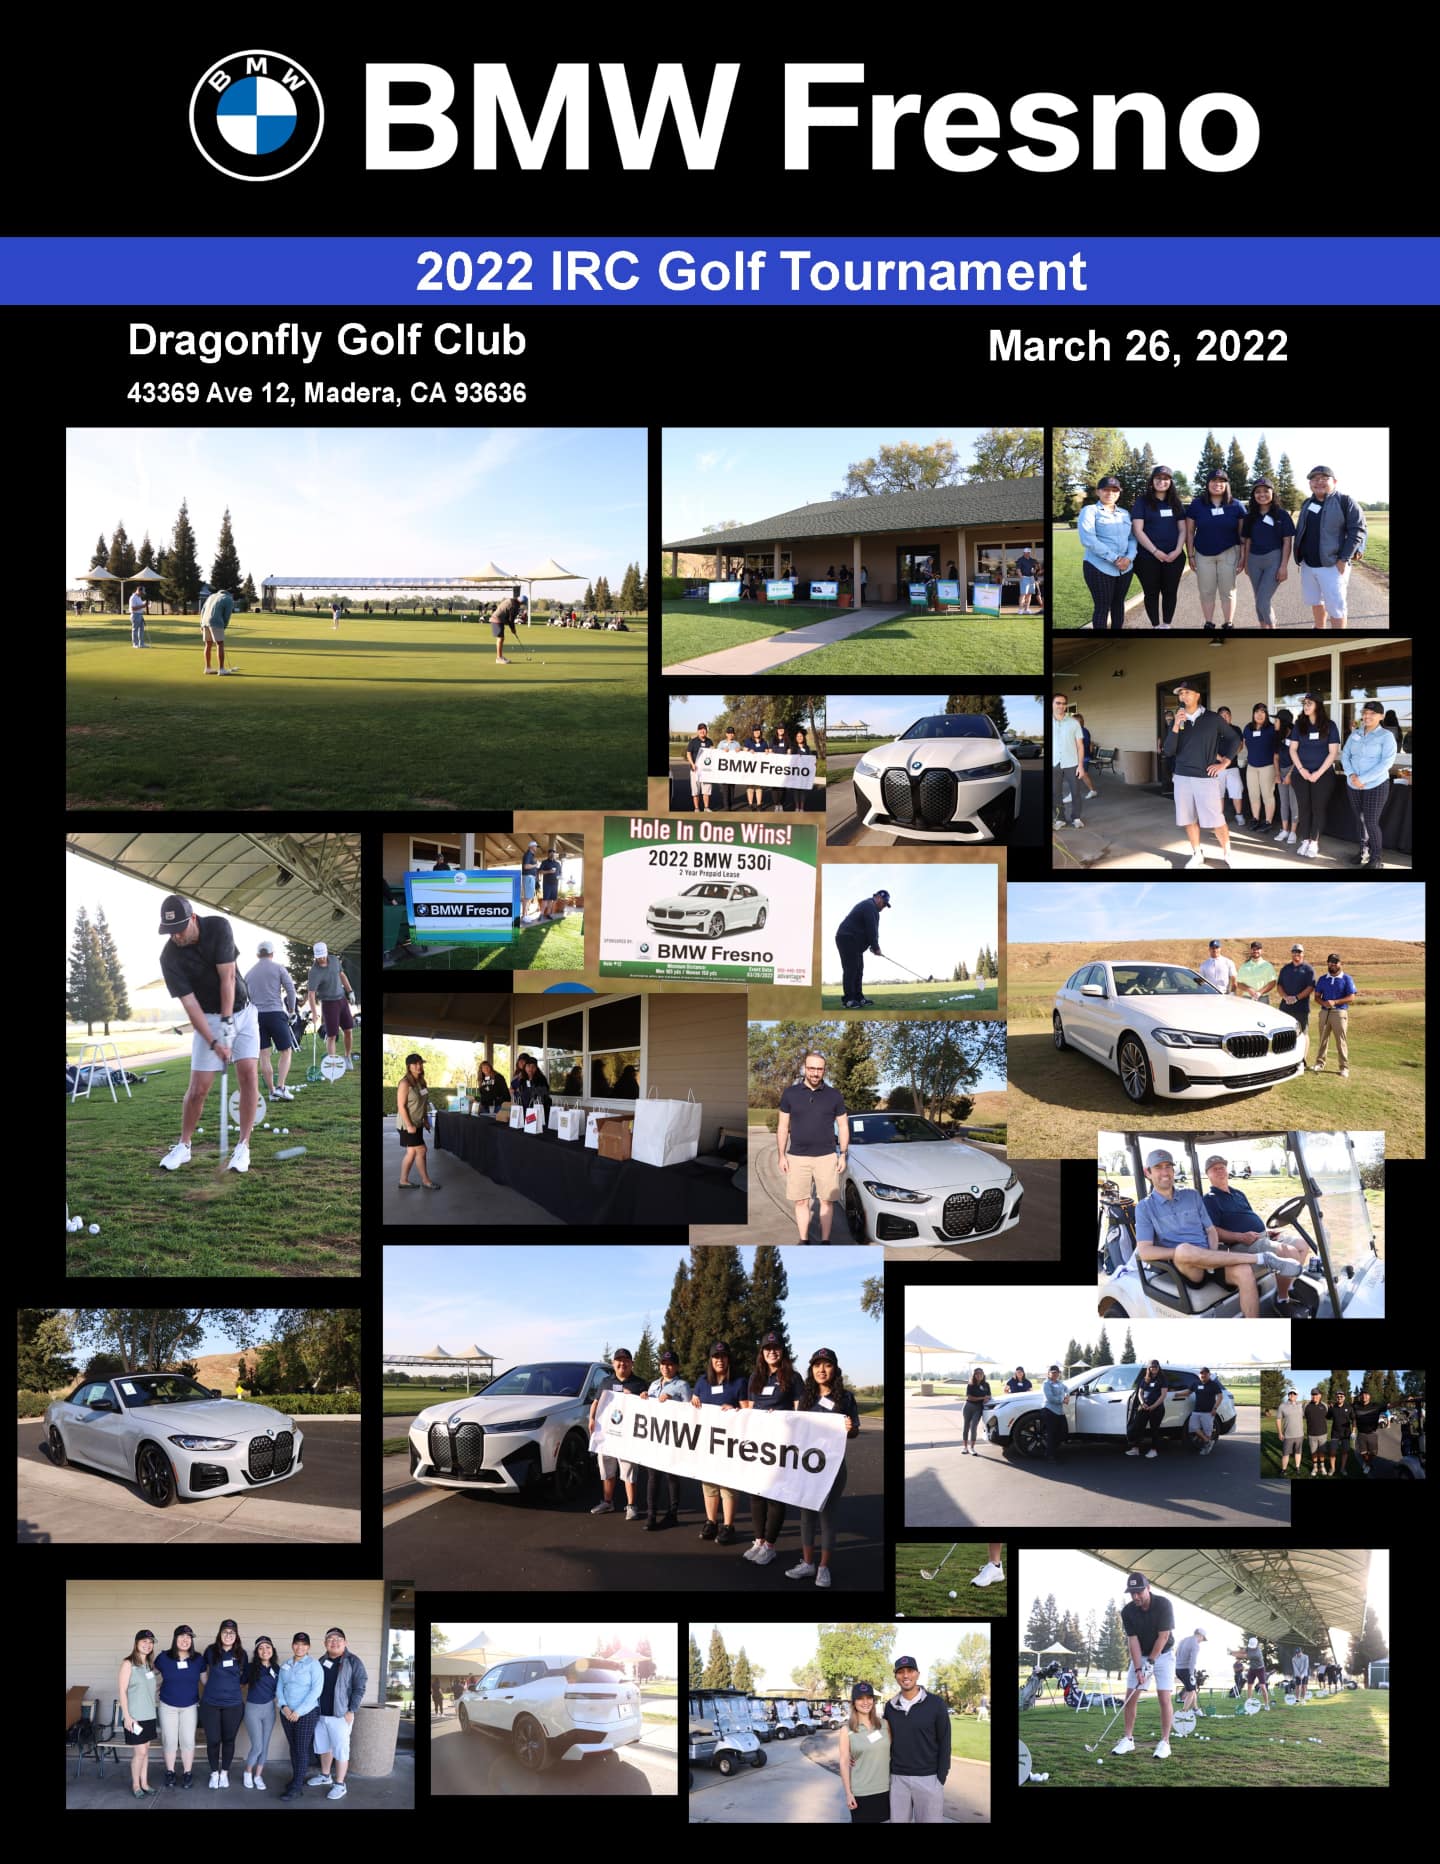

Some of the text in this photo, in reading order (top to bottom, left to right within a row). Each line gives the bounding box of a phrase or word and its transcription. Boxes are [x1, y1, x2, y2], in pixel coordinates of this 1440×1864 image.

[718, 758, 810, 777] BMW Fresno
[630, 818, 792, 845] Hole In One Wins!
[649, 850, 771, 870] 2022 BMW 530i
[685, 869, 698, 877] Year
[699, 870, 722, 878] Prepaid
[431, 905, 509, 916] BMW Fresno
[658, 944, 773, 963] BMW Fresno
[632, 1413, 827, 1474] BMW Fresno
